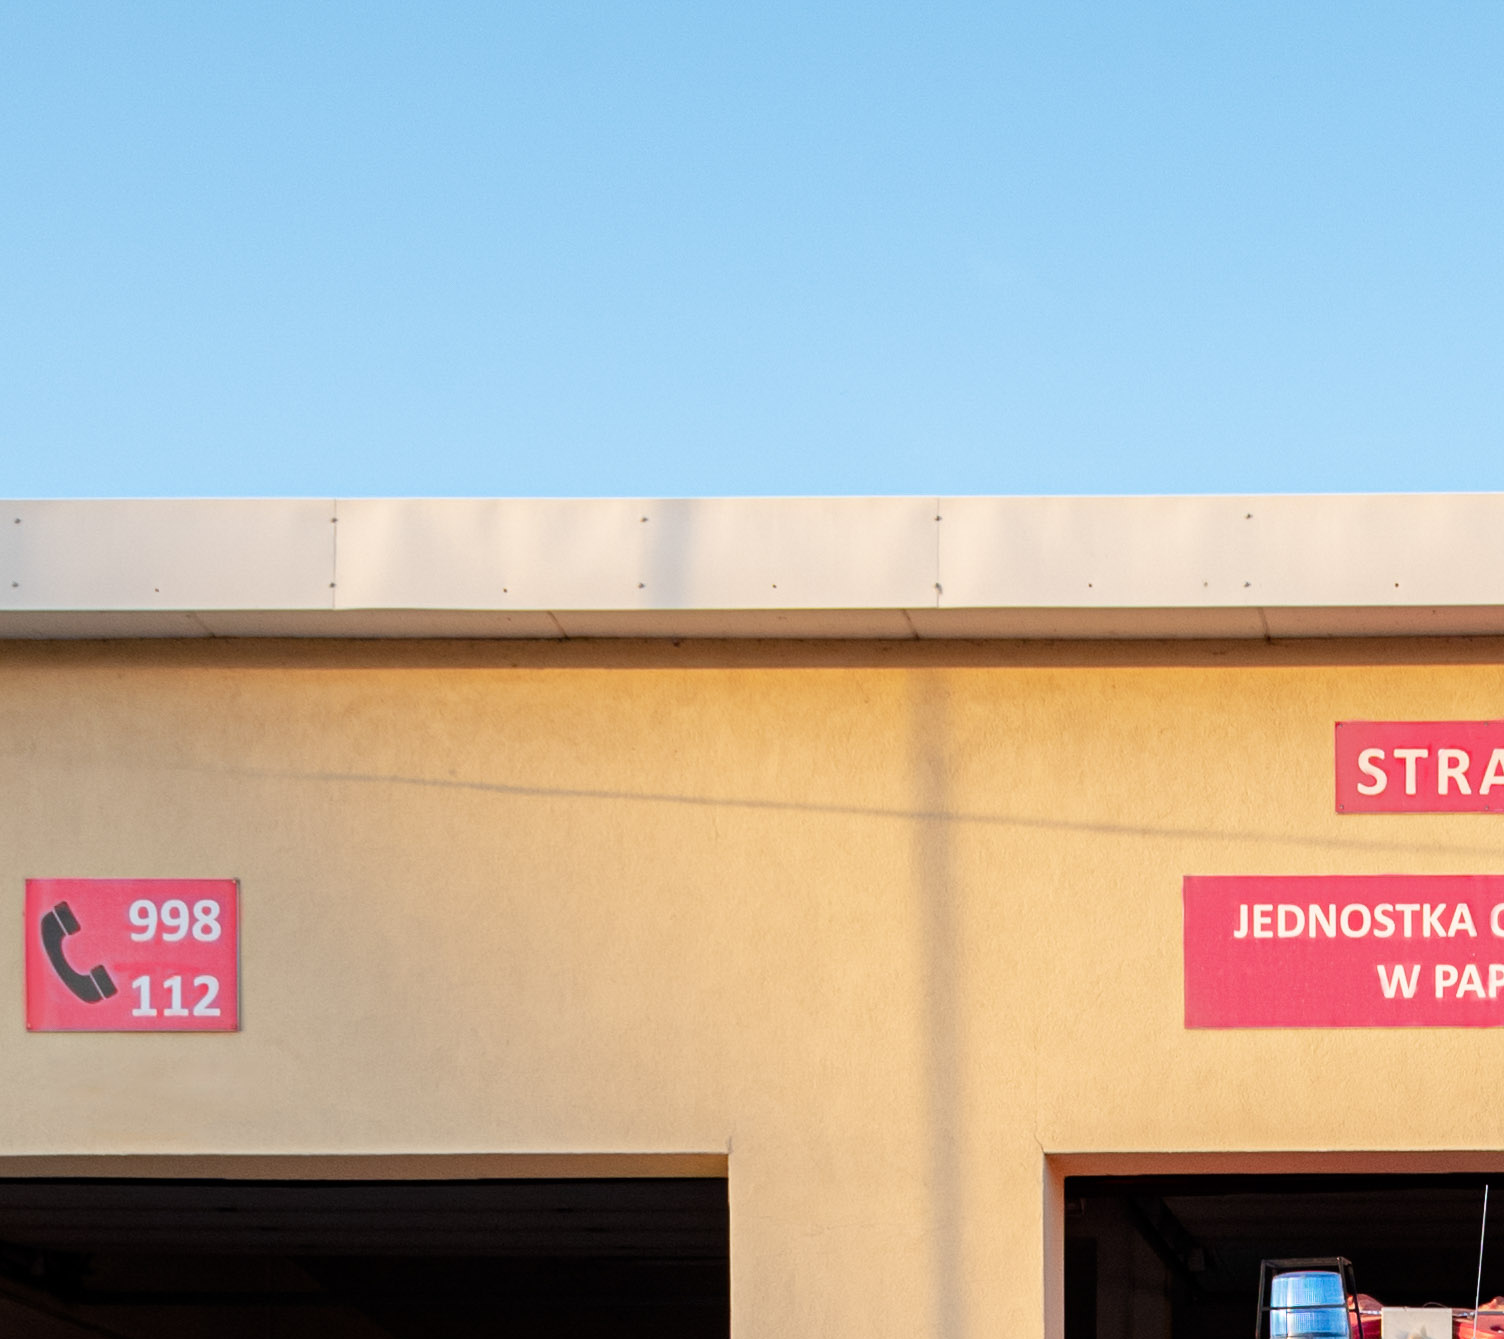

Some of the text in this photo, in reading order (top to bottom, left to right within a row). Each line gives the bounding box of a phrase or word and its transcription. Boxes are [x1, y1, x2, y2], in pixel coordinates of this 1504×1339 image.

[128, 899, 221, 942] 998
[1233, 902, 1476, 940] JEDNOSTKA
[131, 974, 221, 1017] 112
[1376, 965, 1423, 1000] W
